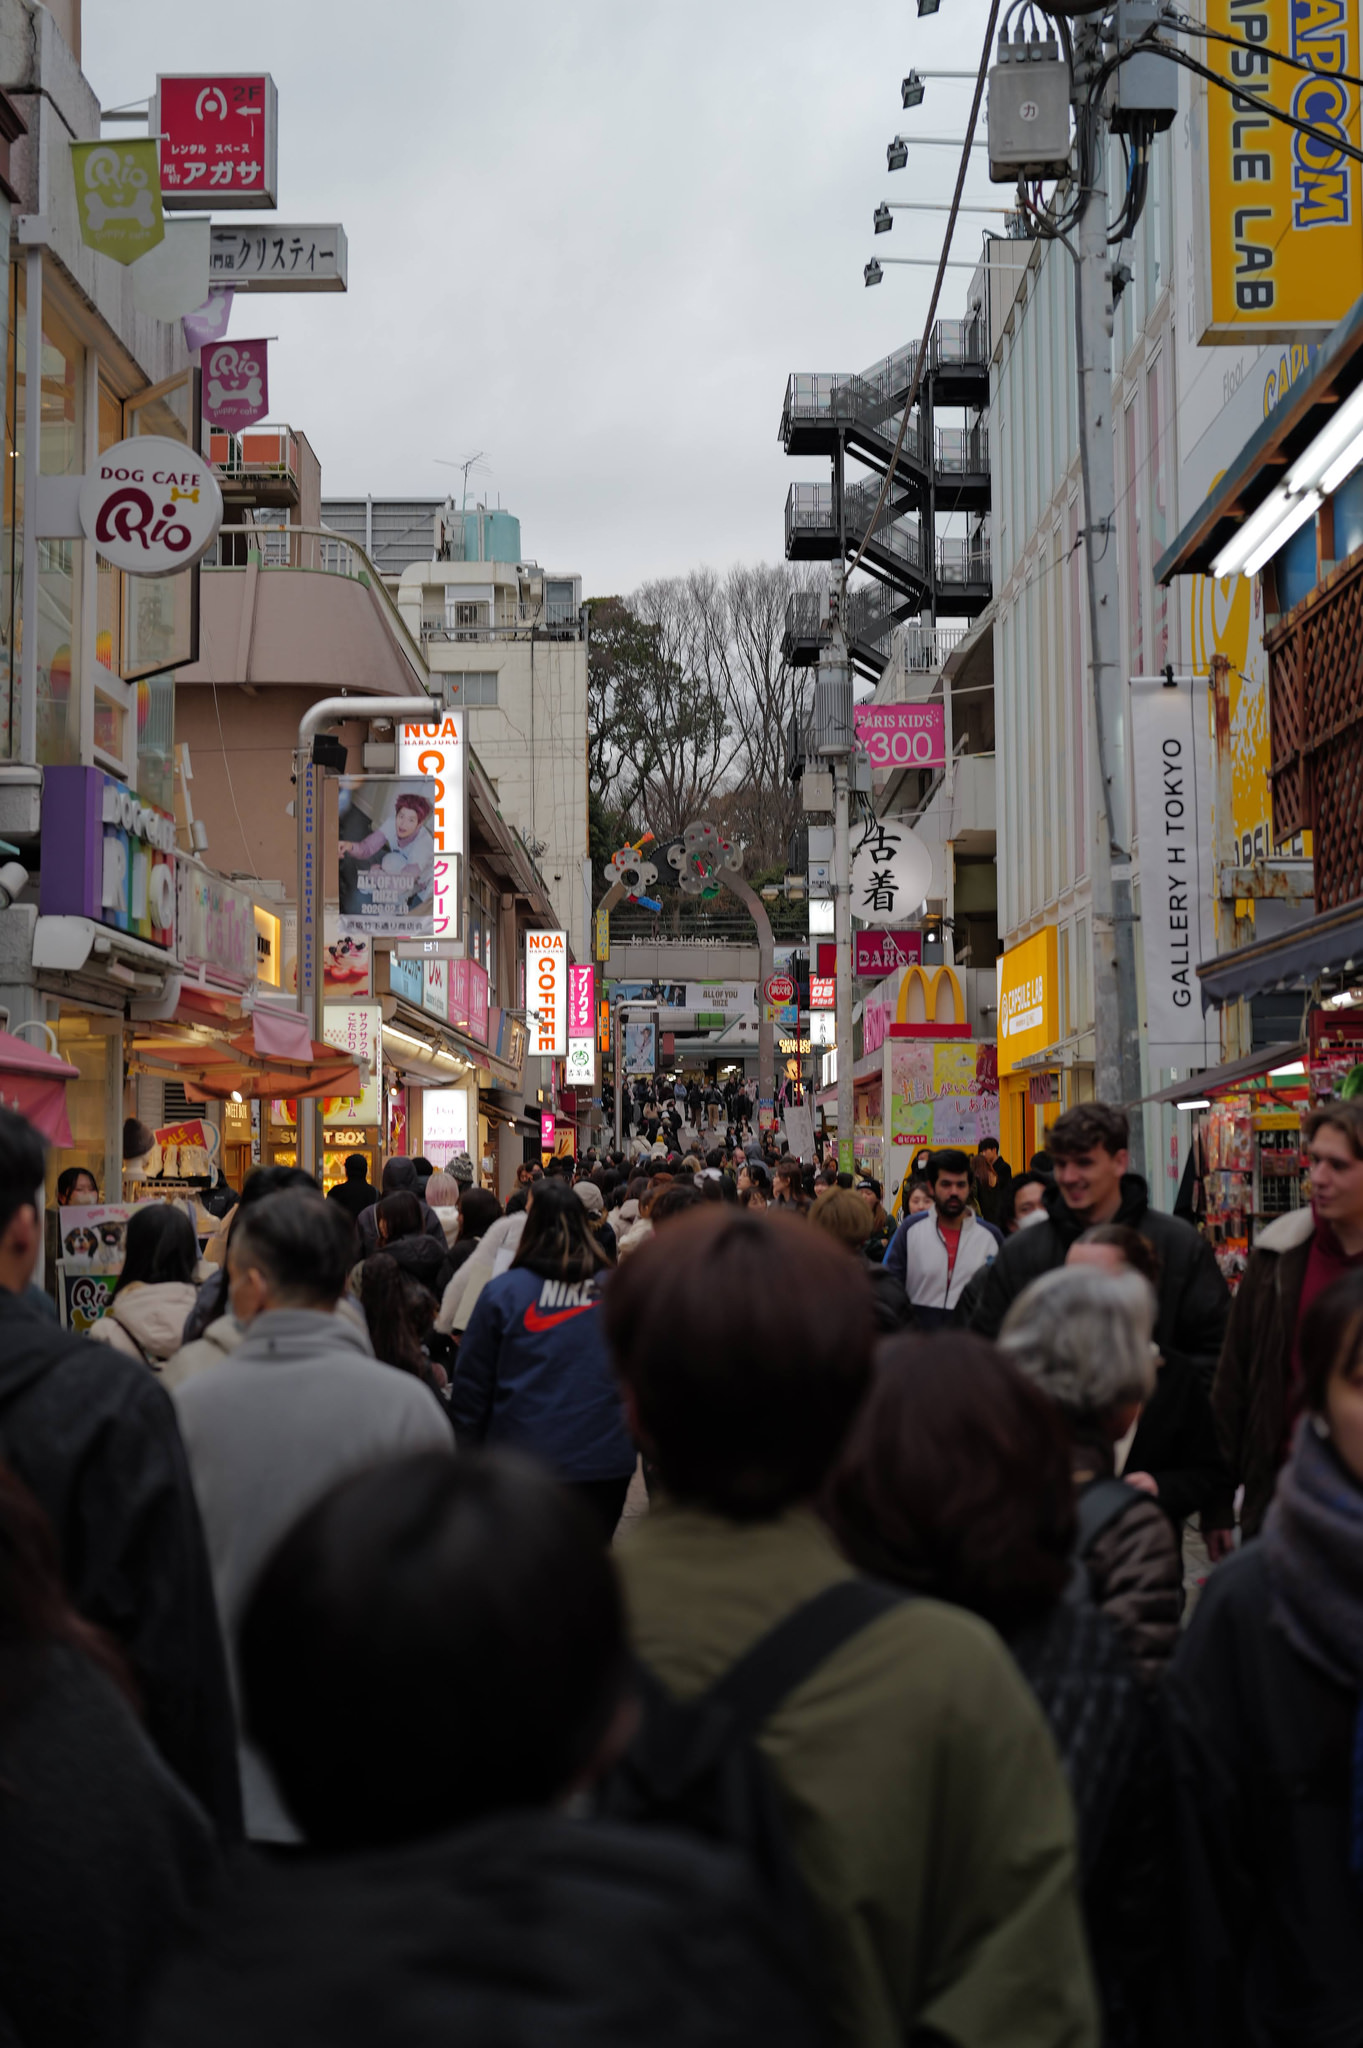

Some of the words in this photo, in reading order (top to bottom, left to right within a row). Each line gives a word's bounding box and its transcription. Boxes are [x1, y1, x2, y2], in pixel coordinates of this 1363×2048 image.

[233, 86, 262, 102] 2F
[171, 144, 206, 154] レンタル
[216, 144, 249, 153] スペース
[183, 161, 261, 185] アガサ
[209, 254, 234, 269] 門店
[236, 237, 334, 272] クリスティー
[1235, 209, 1274, 310] LAB
[100, 467, 144, 482] DOG
[152, 471, 201, 486] CAFE
[95, 487, 192, 552] Rio
[404, 717, 458, 738] NOA
[857, 711, 895, 728] PARIS
[898, 714, 933, 728] KID'S
[1162, 739, 1184, 836] TOKYO
[1167, 848, 1186, 863] H
[862, 826, 901, 912] 古着
[305, 843, 313, 923] TAKESHITA
[529, 935, 564, 949] NOA
[1168, 876, 1192, 1008] GALLERY
[859, 950, 919, 968] DANCE
[538, 957, 556, 1051] COFFEE
[578, 966, 591, 1026] プリクラ
[160, 1127, 187, 1147] SALE
[335, 1131, 366, 1144] BOX
[539, 1278, 595, 1308] NIKE
